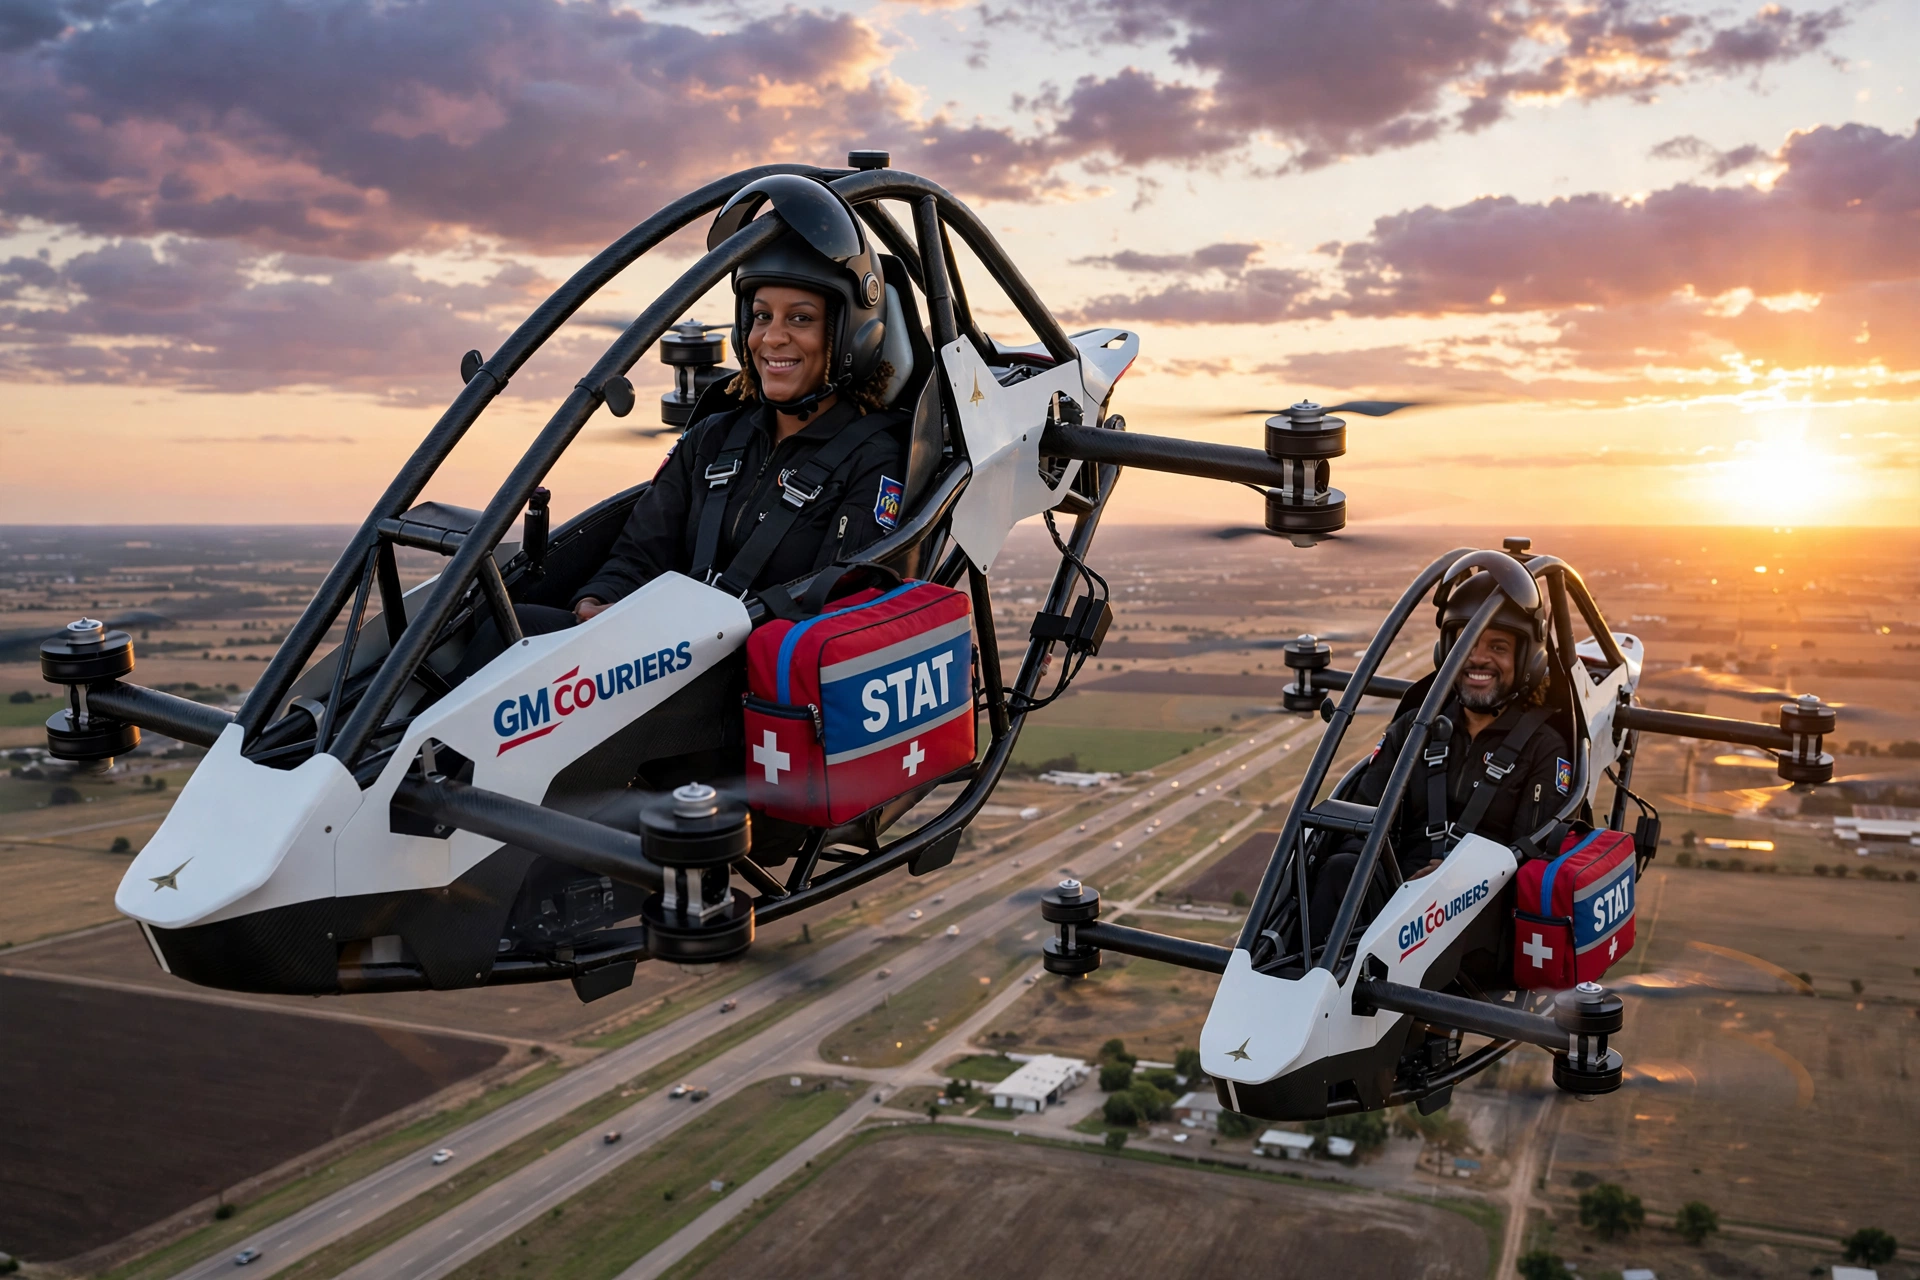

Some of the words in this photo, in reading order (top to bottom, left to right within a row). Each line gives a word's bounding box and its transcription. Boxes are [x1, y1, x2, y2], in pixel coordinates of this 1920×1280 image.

[493, 687, 550, 737] GM
[553, 641, 693, 716] COURIERS
[861, 650, 954, 733] STAT
[1398, 915, 1424, 950] GM
[1425, 879, 1489, 934] COURIERS
[1593, 875, 1630, 932] STAT
